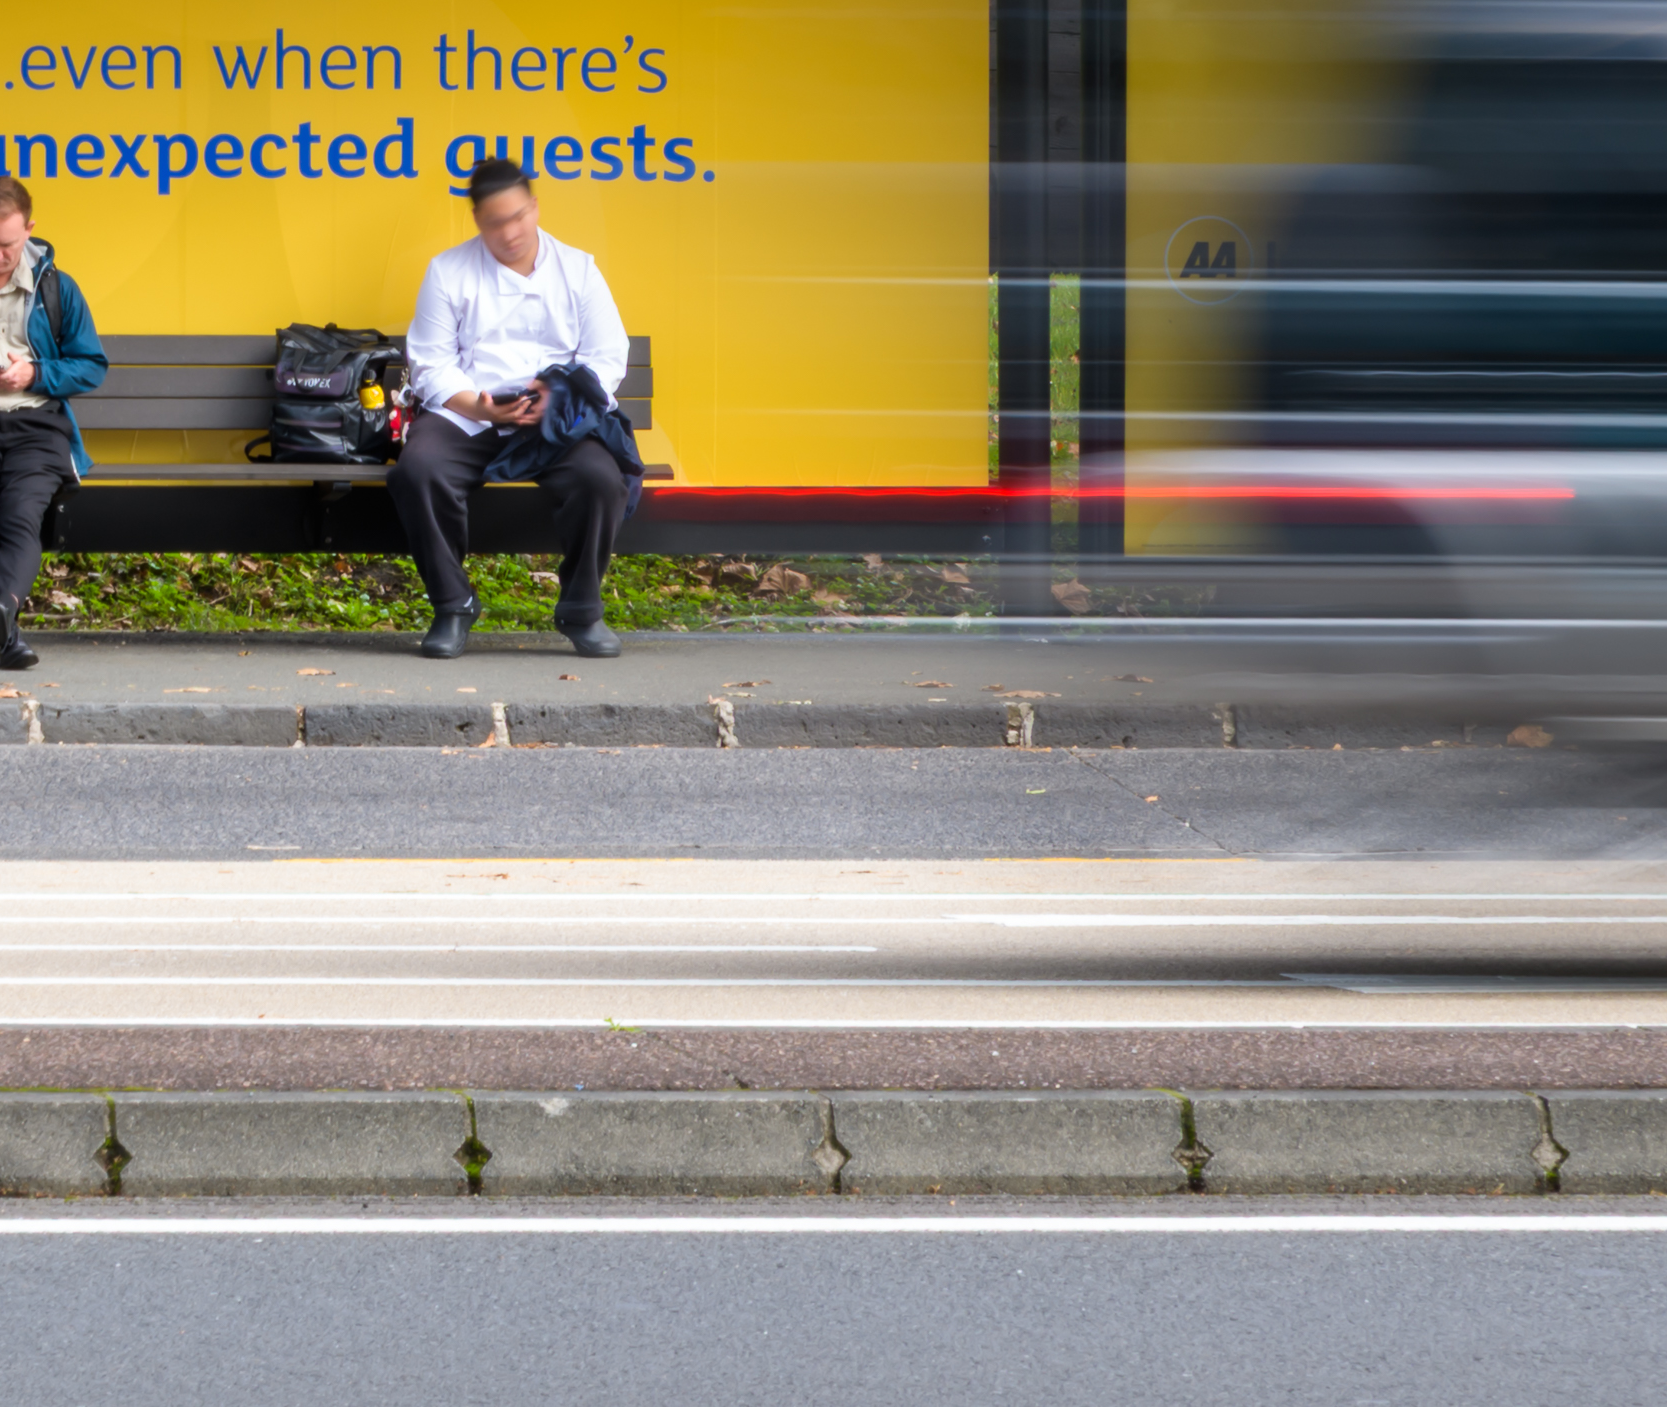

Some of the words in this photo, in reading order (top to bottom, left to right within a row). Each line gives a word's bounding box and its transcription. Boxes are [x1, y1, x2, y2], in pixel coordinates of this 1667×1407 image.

[214, 28, 404, 91] when
[432, 29, 669, 95] there's
[444, 124, 717, 198] guests.
